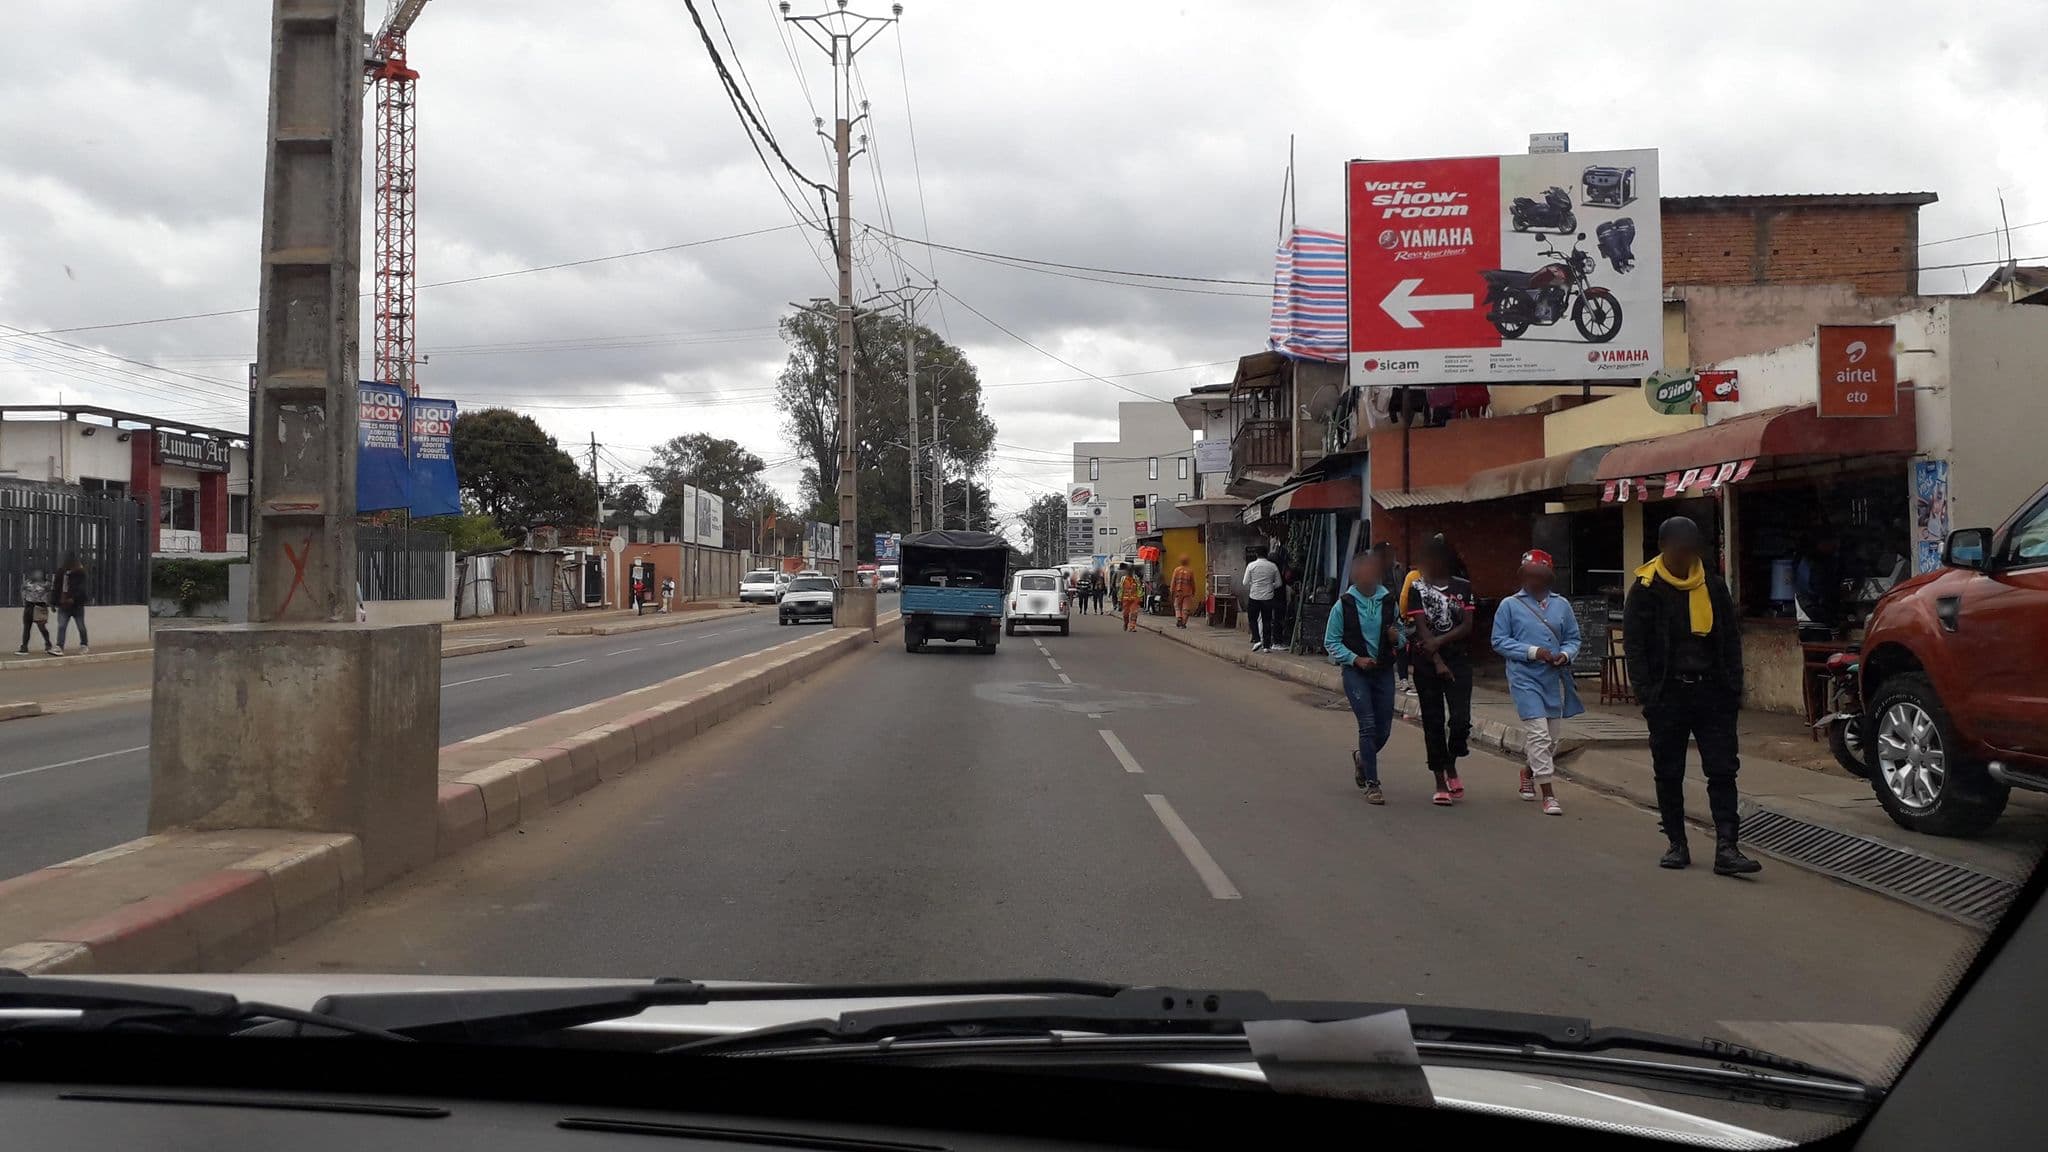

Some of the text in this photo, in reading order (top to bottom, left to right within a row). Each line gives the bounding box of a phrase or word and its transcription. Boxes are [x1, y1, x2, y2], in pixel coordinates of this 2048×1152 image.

[1364, 181, 1426, 191] Votre
[1371, 190, 1468, 206] show-
[1382, 205, 1469, 219] room
[1400, 227, 1474, 248] YAMAHA
[1601, 349, 1649, 361] YAMAHA
[1379, 360, 1419, 371] sicam
[1836, 367, 1878, 383] airtel
[1658, 380, 1693, 400] D'jino
[1846, 391, 1868, 403] eto
[361, 405, 404, 421] MOLY
[414, 421, 452, 434] MOLY
